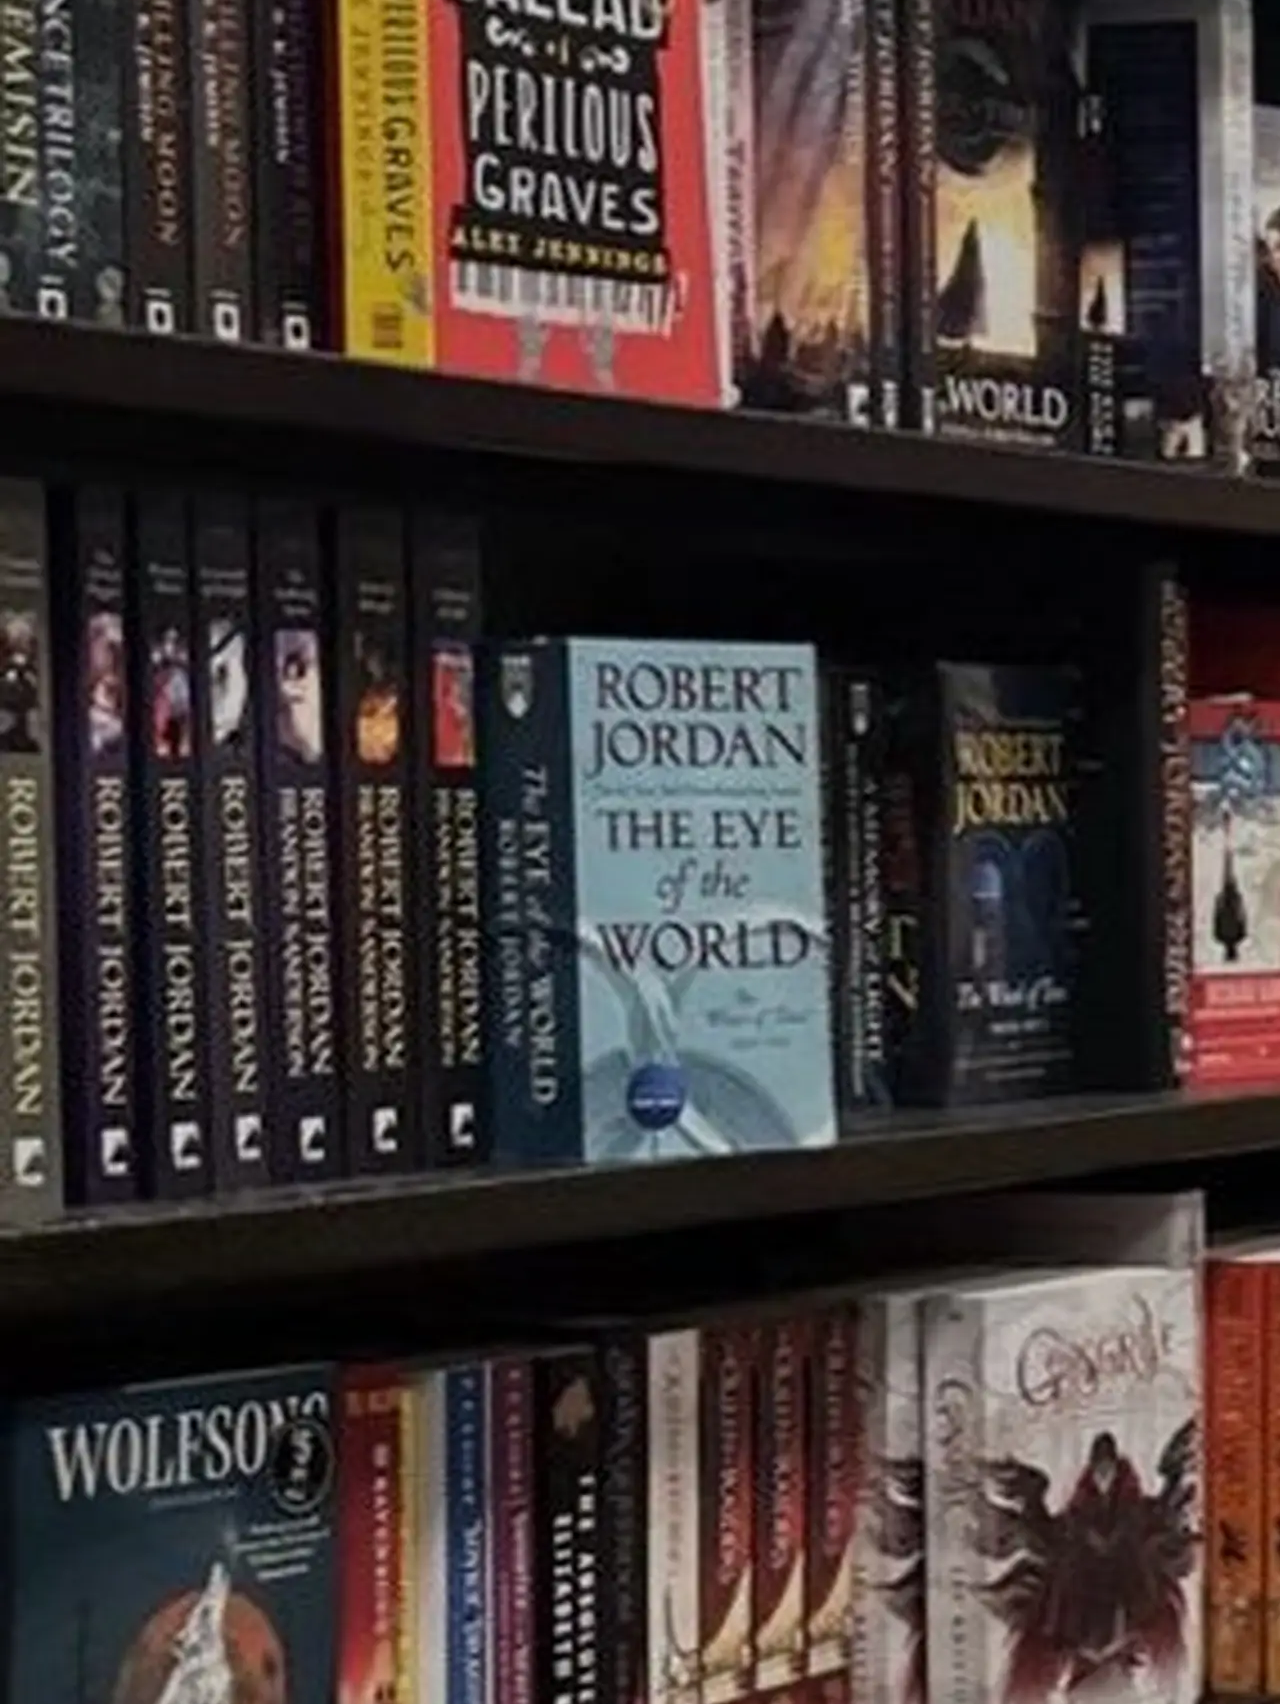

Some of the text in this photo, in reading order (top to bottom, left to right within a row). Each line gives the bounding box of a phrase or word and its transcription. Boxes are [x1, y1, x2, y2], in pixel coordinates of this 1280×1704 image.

[467, 59, 659, 173] PERILOUS
[45, 82, 79, 270] TRILOGY
[153, 133, 181, 249] MOON
[220, 141, 245, 250] MOON
[379, 115, 416, 277] GRAVES
[473, 153, 661, 235] GRAVES
[453, 226, 668, 276] ALEX JENNINGS
[942, 373, 1068, 427] WORLD
[596, 661, 804, 714] ROBERT
[521, 764, 548, 812] The
[587, 719, 807, 782] JORDAN
[953, 731, 1064, 778] ROBERT
[524, 818, 551, 886] EYE
[601, 806, 801, 852] THE EYE
[952, 781, 1069, 835] JORDAN
[222, 776, 257, 1093] ROBERT JORDAN
[301, 787, 332, 1075] ROBERT JORDAN
[375, 785, 405, 1069] ROBERT JORDAN
[453, 788, 481, 1065] ROBERT JORDAN
[655, 855, 752, 915] of the
[8, 777, 43, 1114] ROBERT JORDAN
[98, 776, 129, 1105] ROBERT JORDAN
[161, 779, 196, 1101] ROBERT JORDAN
[597, 918, 809, 973] WORLD
[528, 973, 557, 1105] WORLD
[863, 972, 884, 1066] LIGHT
